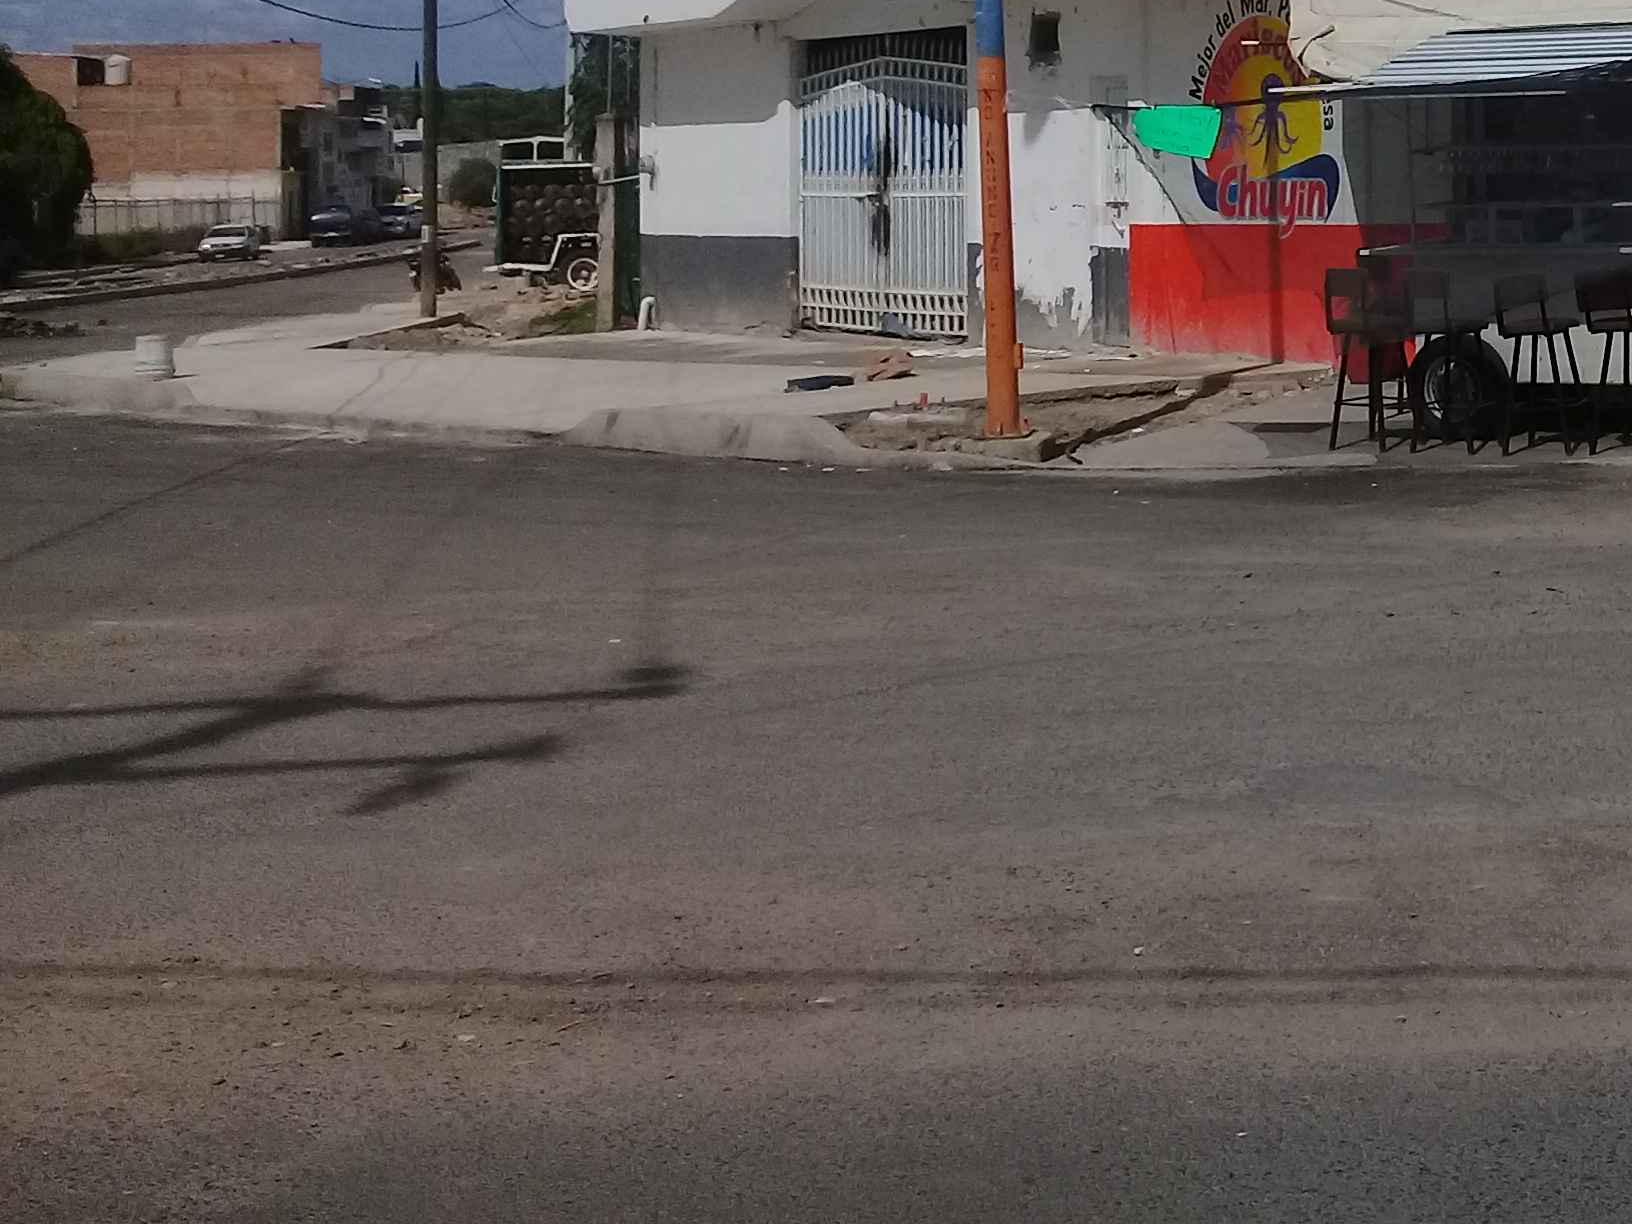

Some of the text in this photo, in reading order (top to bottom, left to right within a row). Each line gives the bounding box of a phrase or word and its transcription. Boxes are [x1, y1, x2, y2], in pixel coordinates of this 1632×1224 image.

[1188, 34, 1217, 101] Mejor
[1215, 0, 1236, 39] del
[1216, 162, 1329, 240] Chuyin
